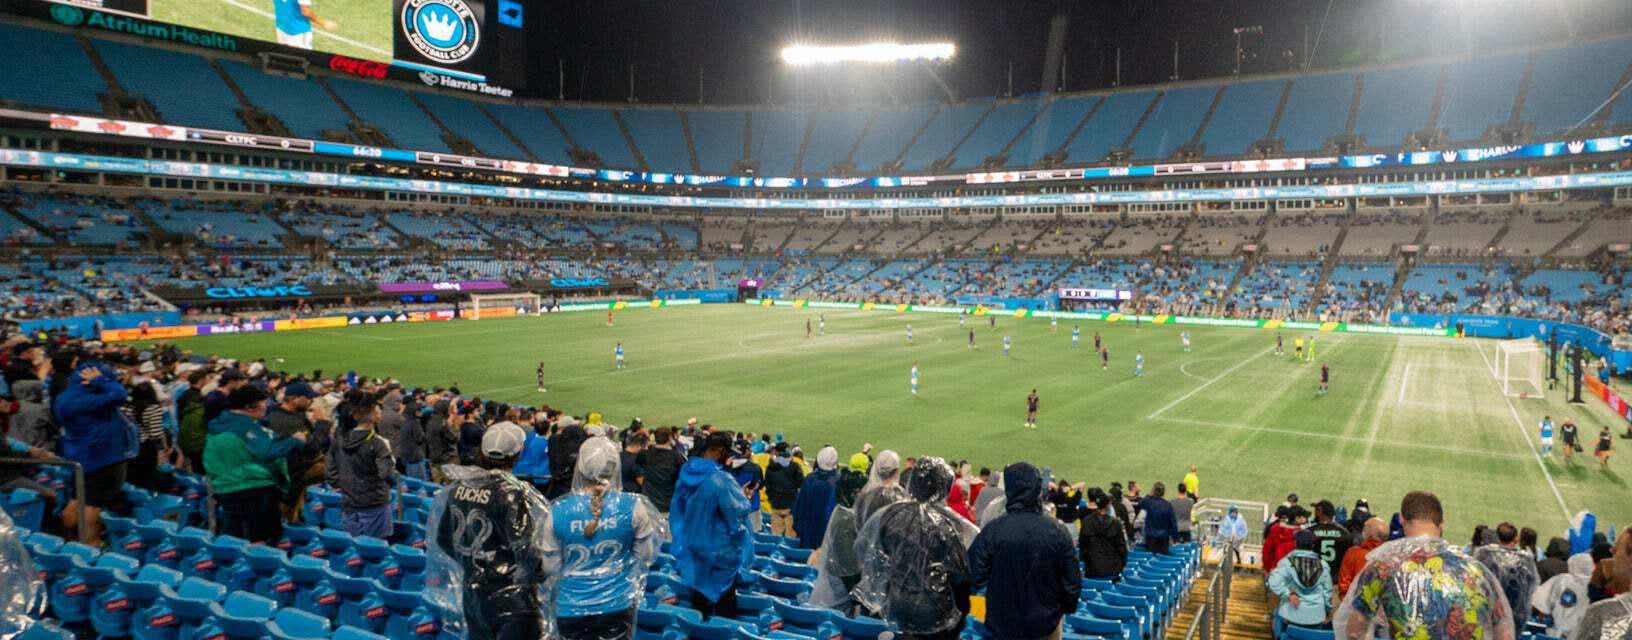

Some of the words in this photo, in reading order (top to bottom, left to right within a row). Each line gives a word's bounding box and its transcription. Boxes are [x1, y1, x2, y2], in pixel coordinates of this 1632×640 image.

[87, 11, 168, 38] Atrium
[171, 27, 236, 49] Health
[440, 76, 478, 91] Harris
[479, 83, 513, 97] Teeter
[454, 486, 492, 504] FUCHS
[570, 517, 617, 533] FUHS
[562, 538, 623, 577] 22
[1321, 540, 1336, 561] 5
